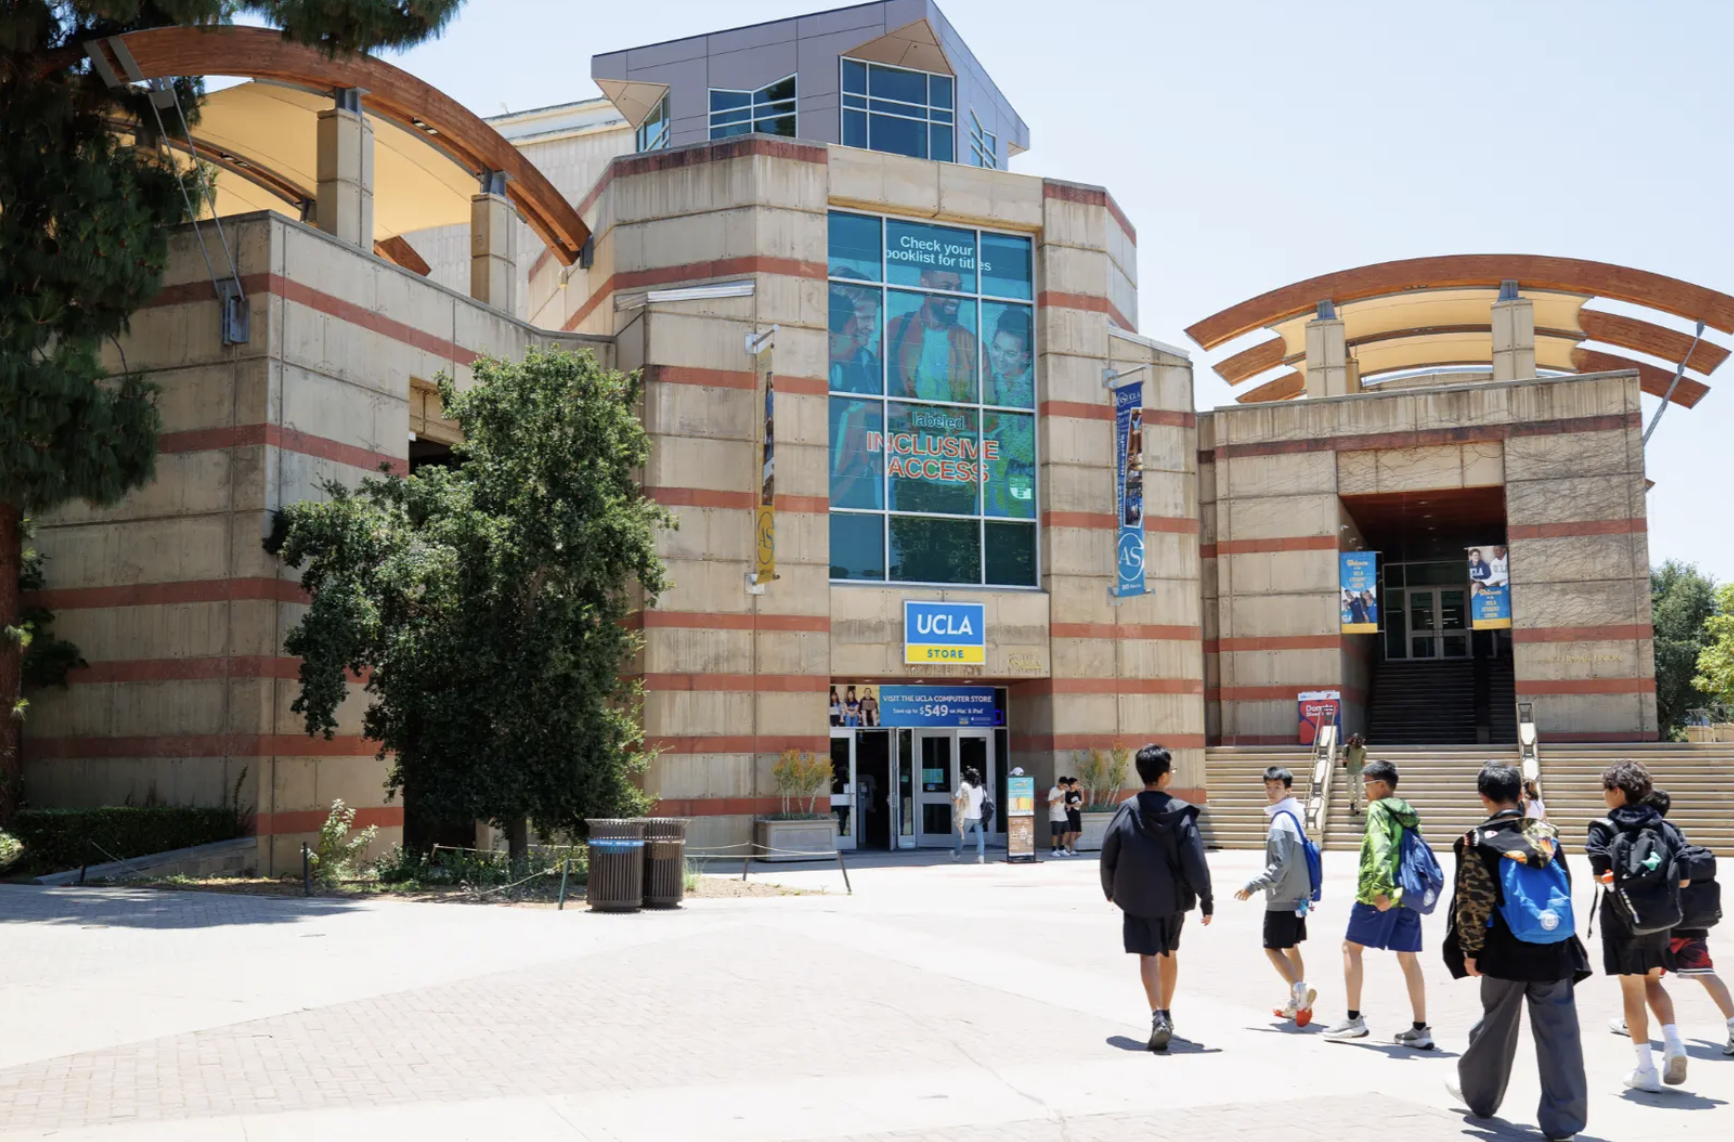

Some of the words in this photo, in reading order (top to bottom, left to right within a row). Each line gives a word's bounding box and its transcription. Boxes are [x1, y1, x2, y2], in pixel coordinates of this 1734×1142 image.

[900, 236, 940, 252] Check
[944, 243, 973, 256] your
[938, 253, 956, 267] for
[958, 257, 992, 271] titles
[912, 411, 965, 430] labeled
[866, 430, 1000, 461] INCLUSIVE
[888, 456, 990, 483] ACCESS
[1118, 546, 1144, 567] AS
[917, 614, 973, 636] UCLA
[927, 649, 965, 659] STORE
[919, 704, 949, 717] $549
